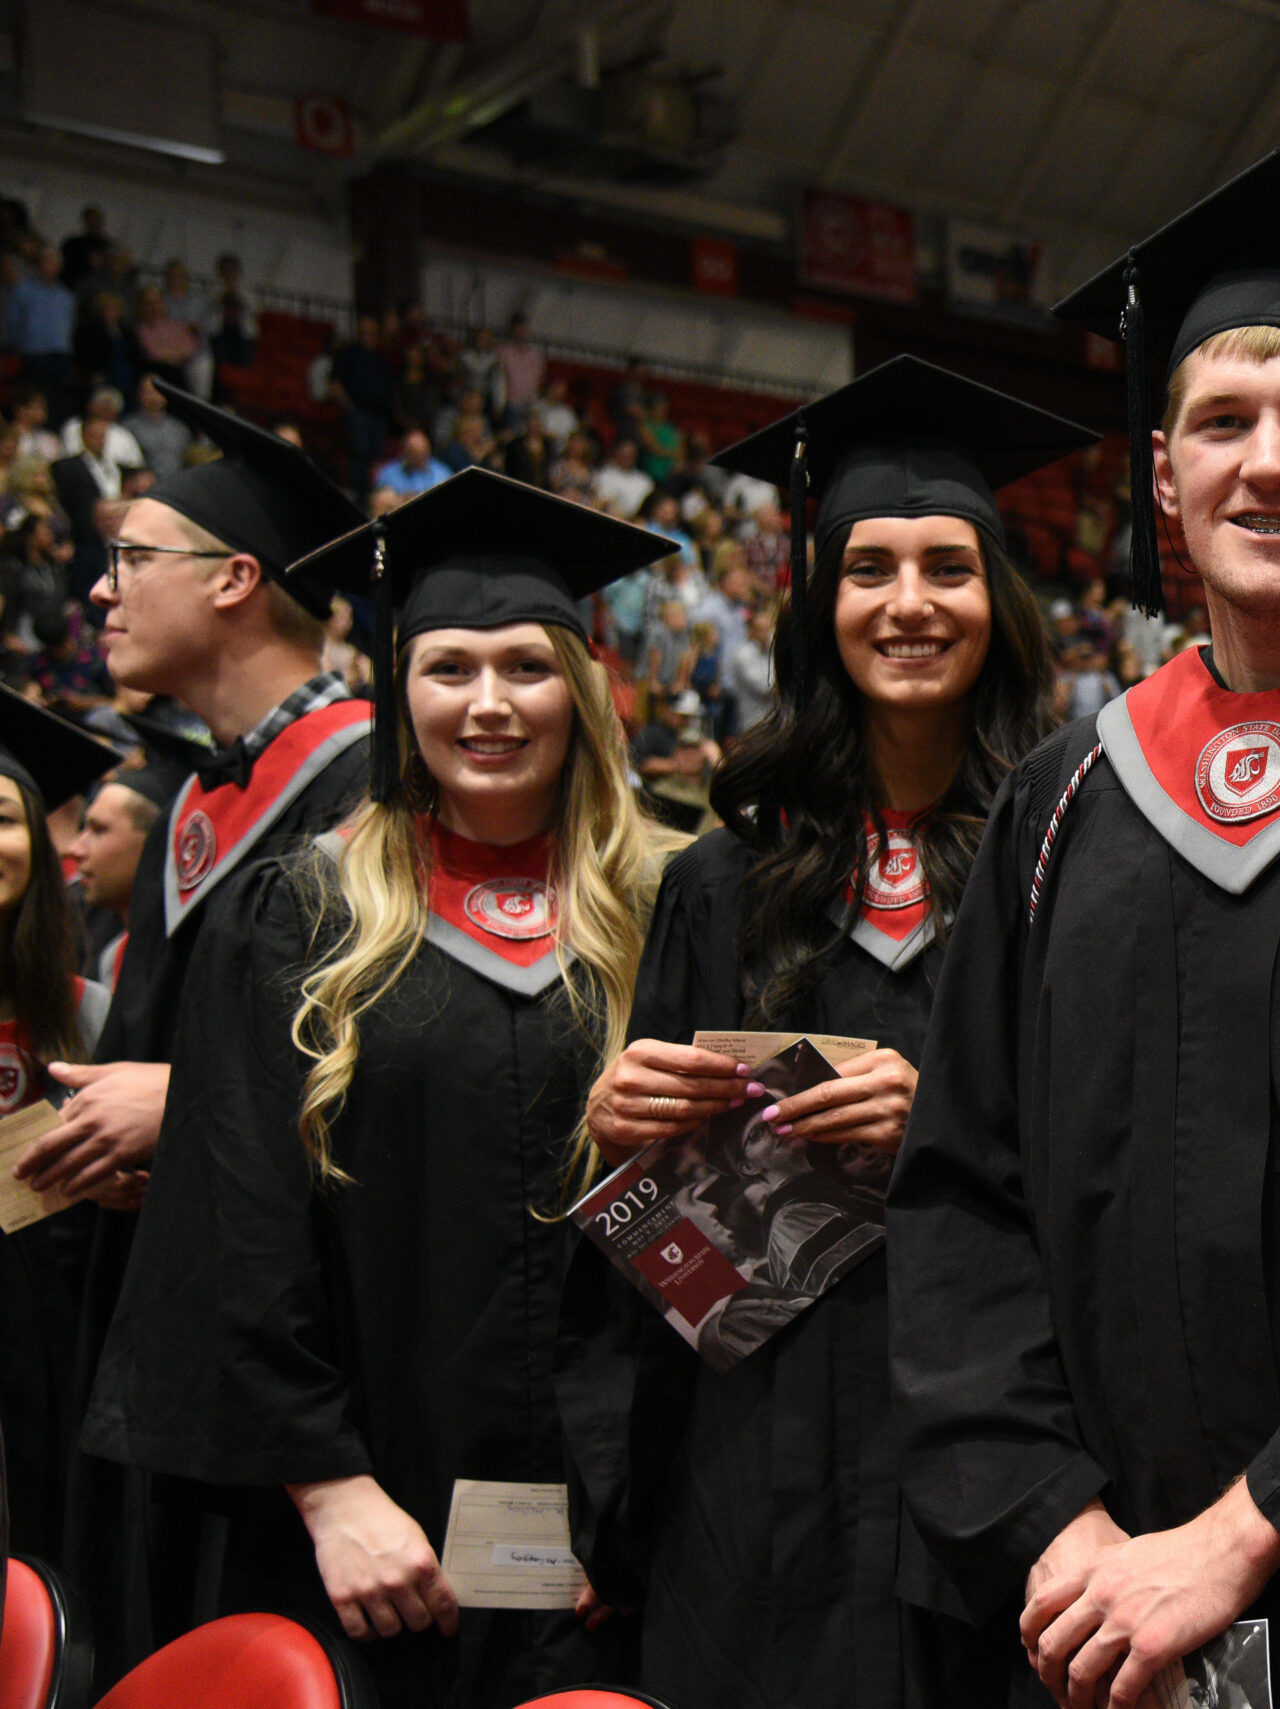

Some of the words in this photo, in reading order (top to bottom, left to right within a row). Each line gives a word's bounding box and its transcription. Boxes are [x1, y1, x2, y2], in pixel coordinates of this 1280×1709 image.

[1198, 727, 1240, 788] WASHINGTON
[1242, 723, 1271, 732] STATE
[1210, 802, 1253, 817] FOUNDED
[1256, 794, 1279, 811] 1890
[595, 1177, 658, 1237] 2019
[617, 1201, 674, 1249] COMMENCEMENT
